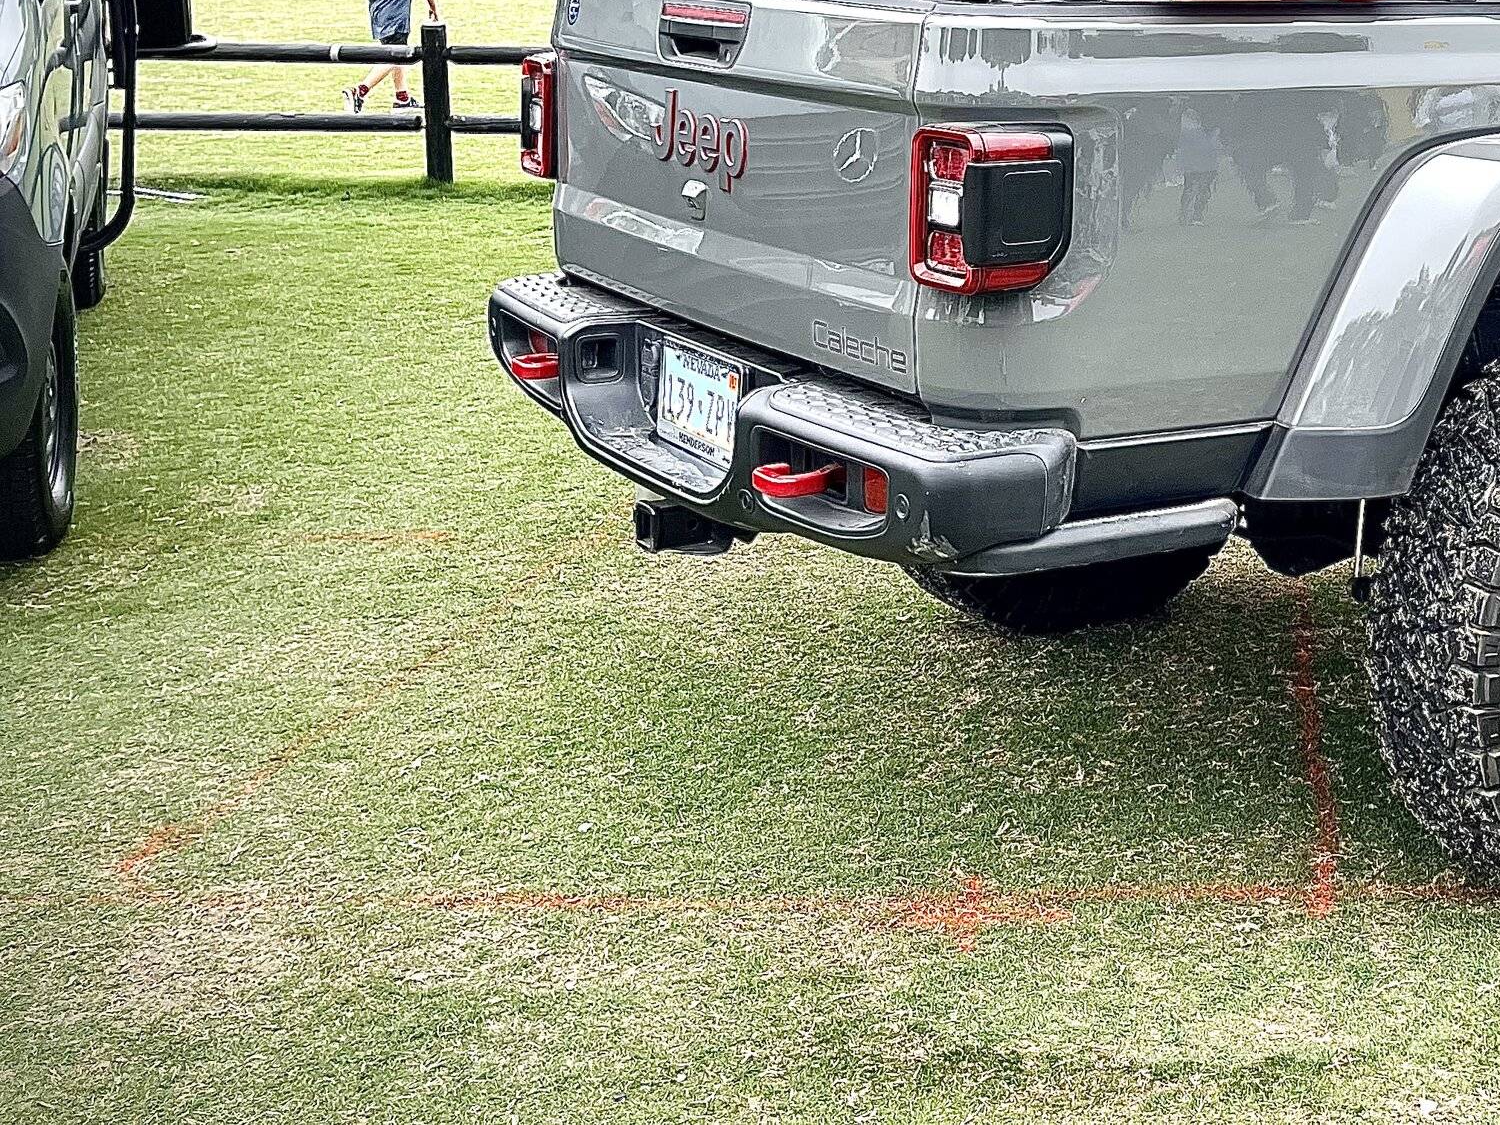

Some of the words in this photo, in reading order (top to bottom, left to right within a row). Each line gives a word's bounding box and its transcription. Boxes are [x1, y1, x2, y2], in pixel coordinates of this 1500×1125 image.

[650, 87, 749, 194] Jeep
[811, 319, 907, 374] Caleche
[682, 354, 722, 382] NEVADA
[678, 431, 716, 457] HENDERSON
